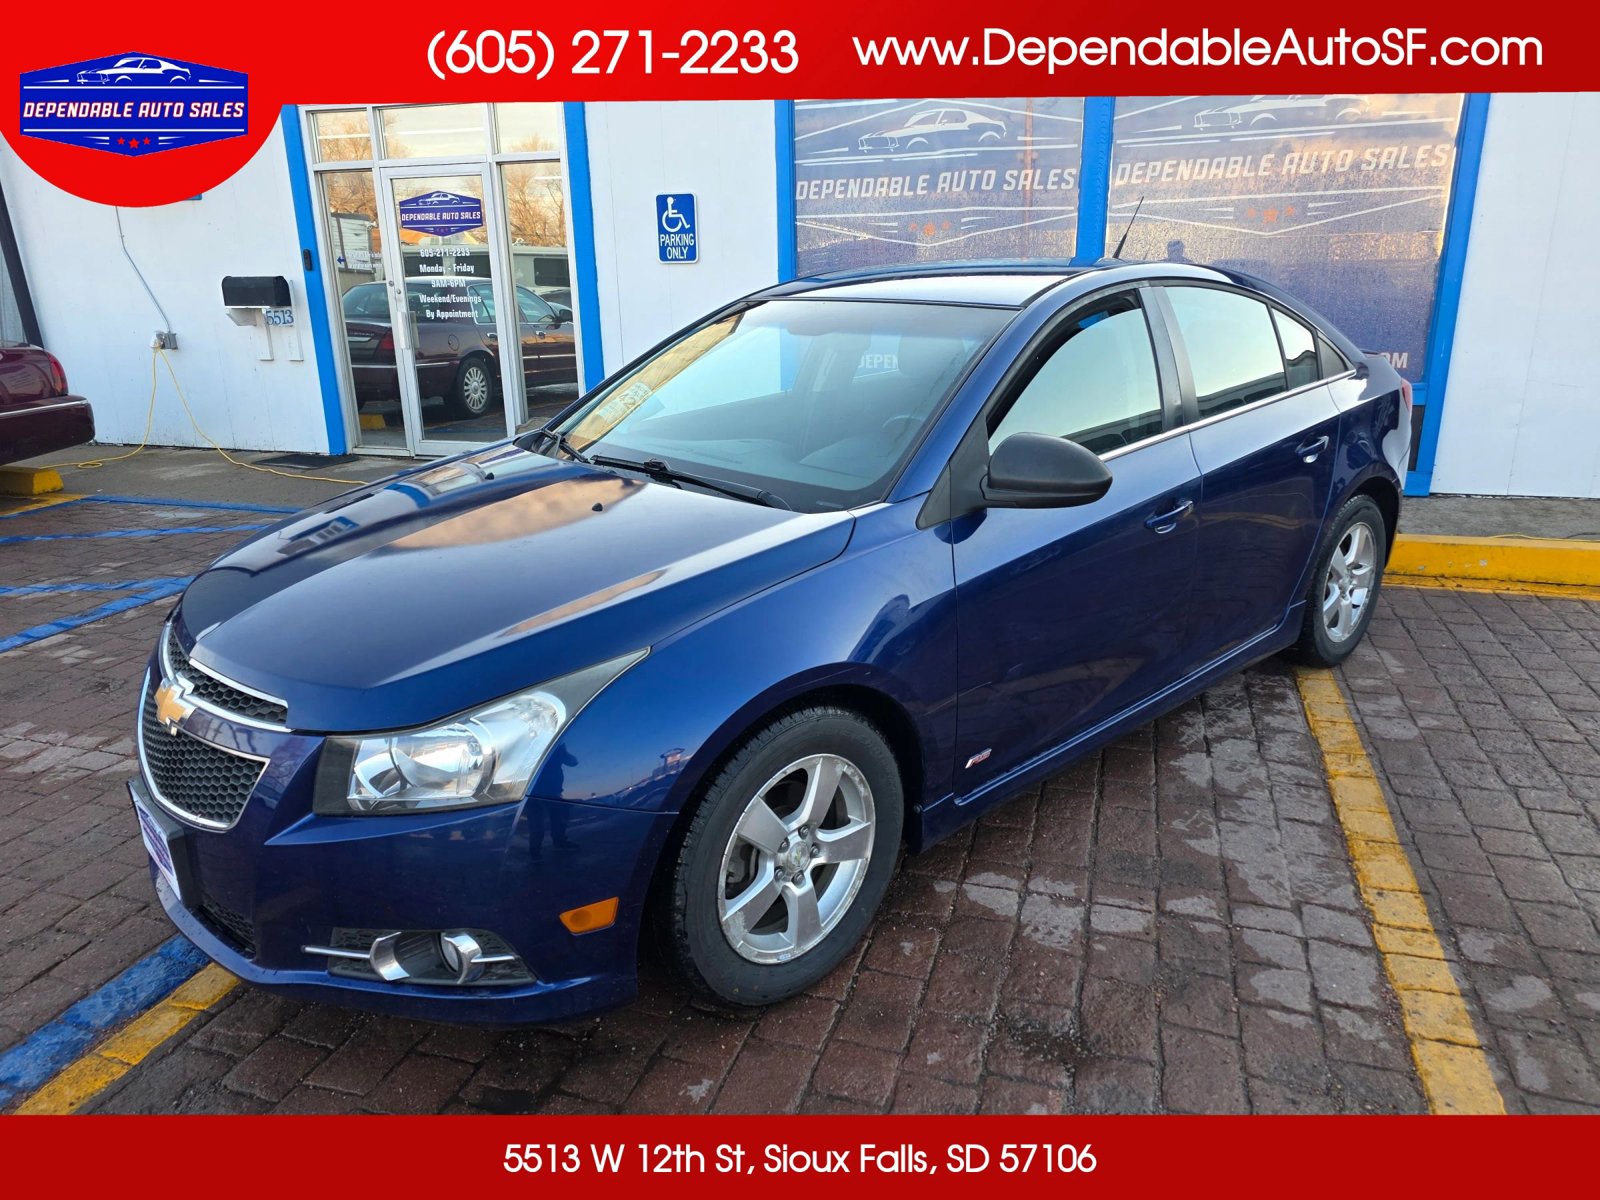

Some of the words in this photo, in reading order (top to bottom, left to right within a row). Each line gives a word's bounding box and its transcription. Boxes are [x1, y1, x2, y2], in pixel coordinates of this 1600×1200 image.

[1115, 154, 1275, 187] DEPENDABLE
[1282, 149, 1351, 176] AUTO
[1361, 143, 1451, 171] SALES
[795, 174, 930, 200] DEPENDABLE
[937, 169, 996, 193] AUTO
[1003, 168, 1077, 191] SALES
[401, 212, 441, 221] DEPENDABLE
[442, 212, 459, 220] AUTO
[460, 211, 481, 219] SALES
[660, 233, 695, 246] PARKING
[420, 248, 471, 257] 605-271-2233
[666, 246, 689, 259] ONLY
[419, 264, 446, 273] Monday
[453, 263, 475, 273] Friday
[419, 294, 482, 304] Weekend/Evenings
[266, 309, 295, 326] 5513
[426, 310, 435, 320] By
[436, 310, 479, 320] Appointment
